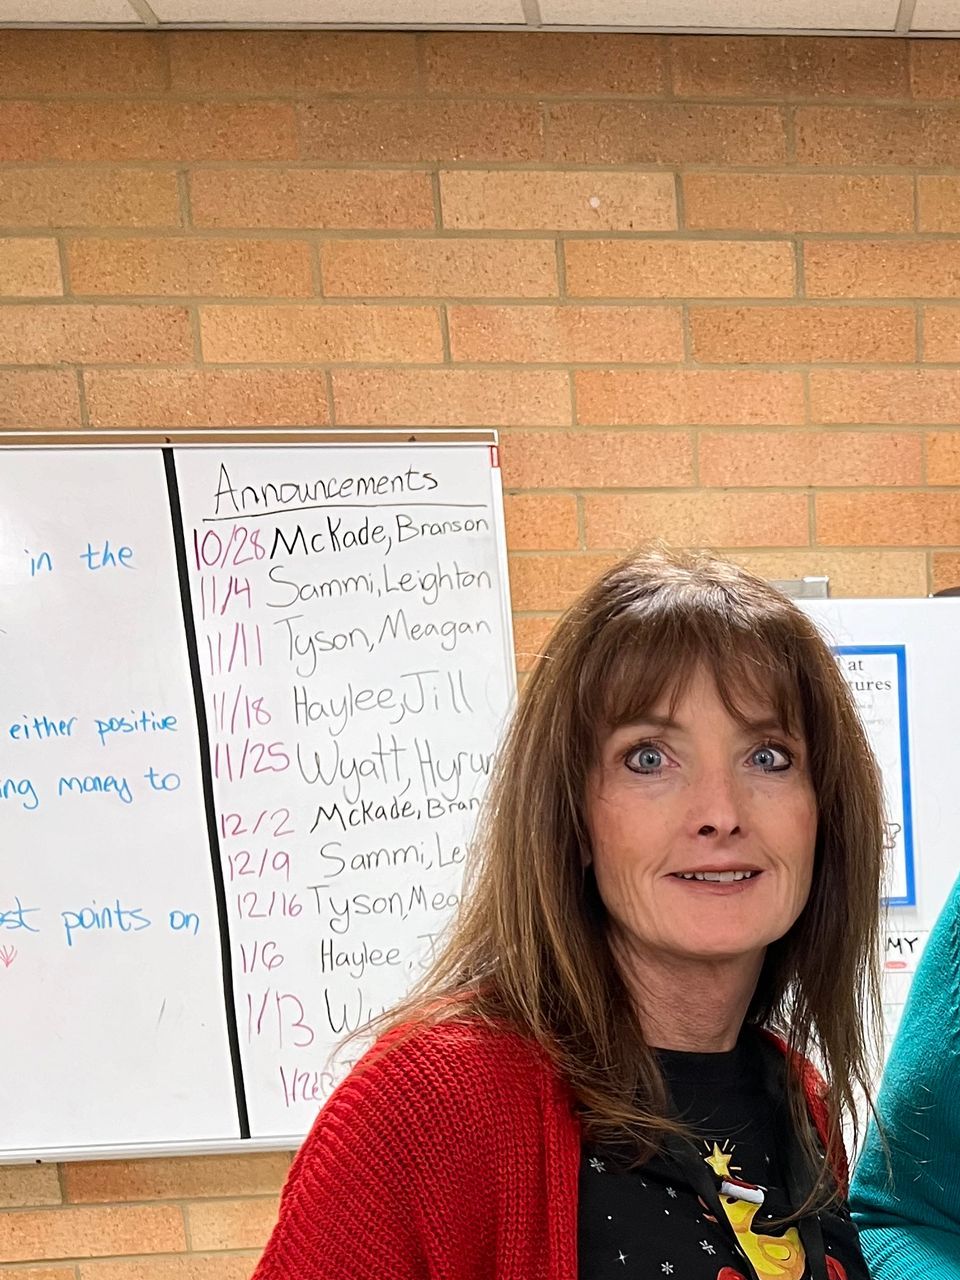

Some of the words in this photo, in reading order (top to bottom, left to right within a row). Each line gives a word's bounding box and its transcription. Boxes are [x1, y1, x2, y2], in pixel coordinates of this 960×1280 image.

[214, 462, 439, 514] Announcements
[24, 548, 54, 577] in
[79, 539, 139, 572] the
[193, 524, 265, 570] 10/28
[270, 516, 392, 559] McKade,
[396, 514, 489, 543] Branson
[200, 575, 252, 620] 11/4
[266, 565, 381, 608] Sammi,
[383, 560, 492, 605] Leighton
[207, 622, 262, 676] 11/11
[273, 614, 376, 678] Tyson,
[378, 608, 492, 652] Meagan
[848, 659, 865, 672] at
[213, 684, 272, 735] 11/18
[293, 683, 406, 736] Haylee,
[400, 670, 474, 714] Jill
[9, 713, 79, 742] either
[96, 708, 180, 746] positive
[214, 738, 291, 782] 11/25
[58, 775, 134, 804] money
[143, 766, 182, 792] to
[221, 808, 295, 838] 12/2
[427, 797, 480, 820] Bran
[227, 848, 290, 882] 12/9
[319, 841, 433, 878] Sammi,
[61, 899, 152, 947] points
[169, 910, 201, 936] on
[237, 891, 303, 919] 12/16
[241, 941, 285, 974] 1/6
[321, 938, 413, 979] Haylee,
[247, 987, 315, 1050] 1/13
